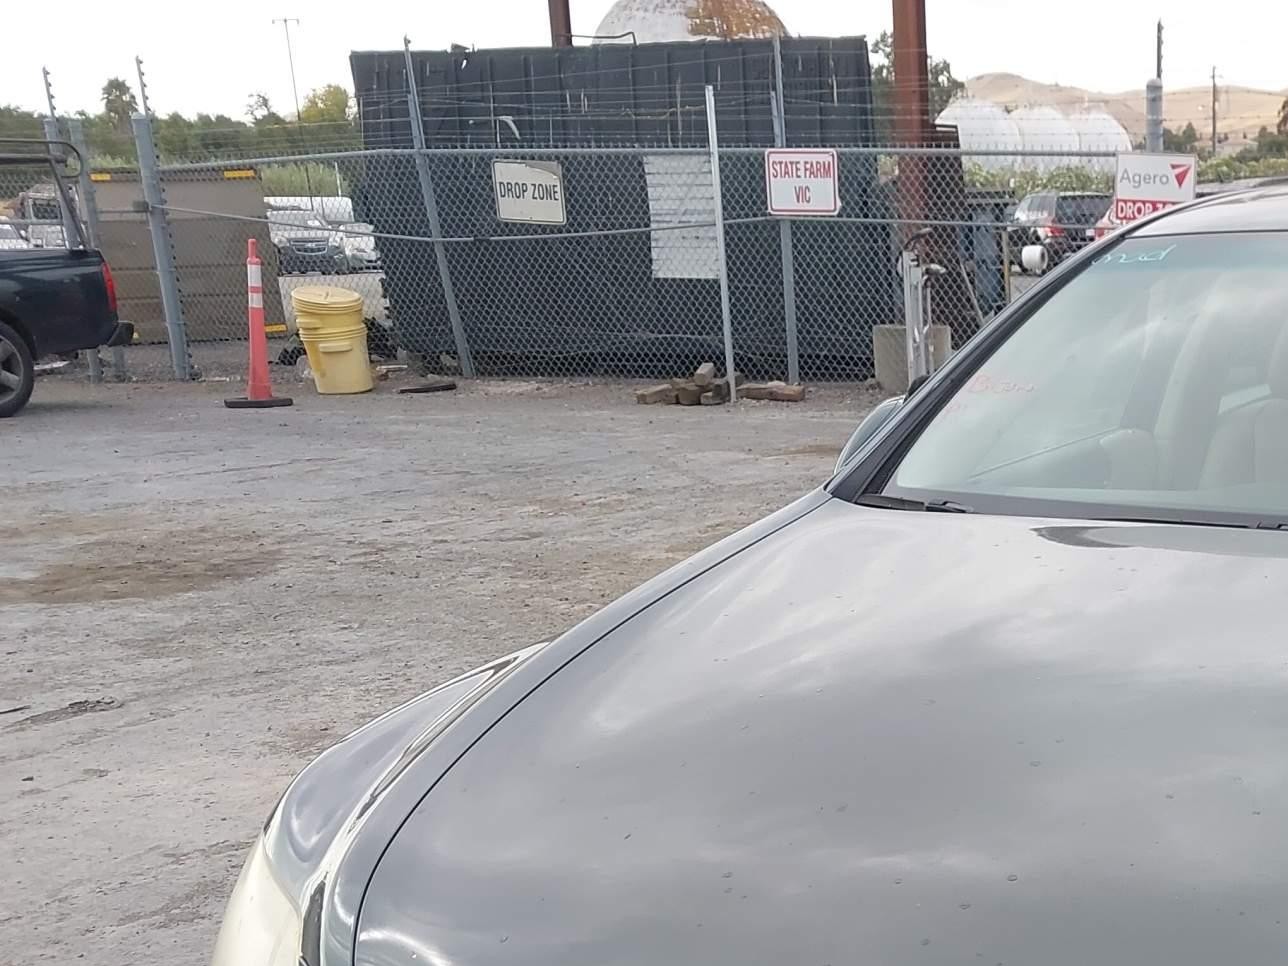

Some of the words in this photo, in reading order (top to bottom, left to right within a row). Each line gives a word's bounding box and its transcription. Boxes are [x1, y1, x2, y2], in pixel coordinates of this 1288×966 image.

[771, 160, 801, 179] STATE
[803, 160, 832, 179] FARM
[1119, 167, 1170, 189] Agero
[498, 181, 528, 199] DROP
[530, 183, 560, 201] ZONE
[793, 184, 812, 204] VIC
[1116, 201, 1153, 220] DROP
